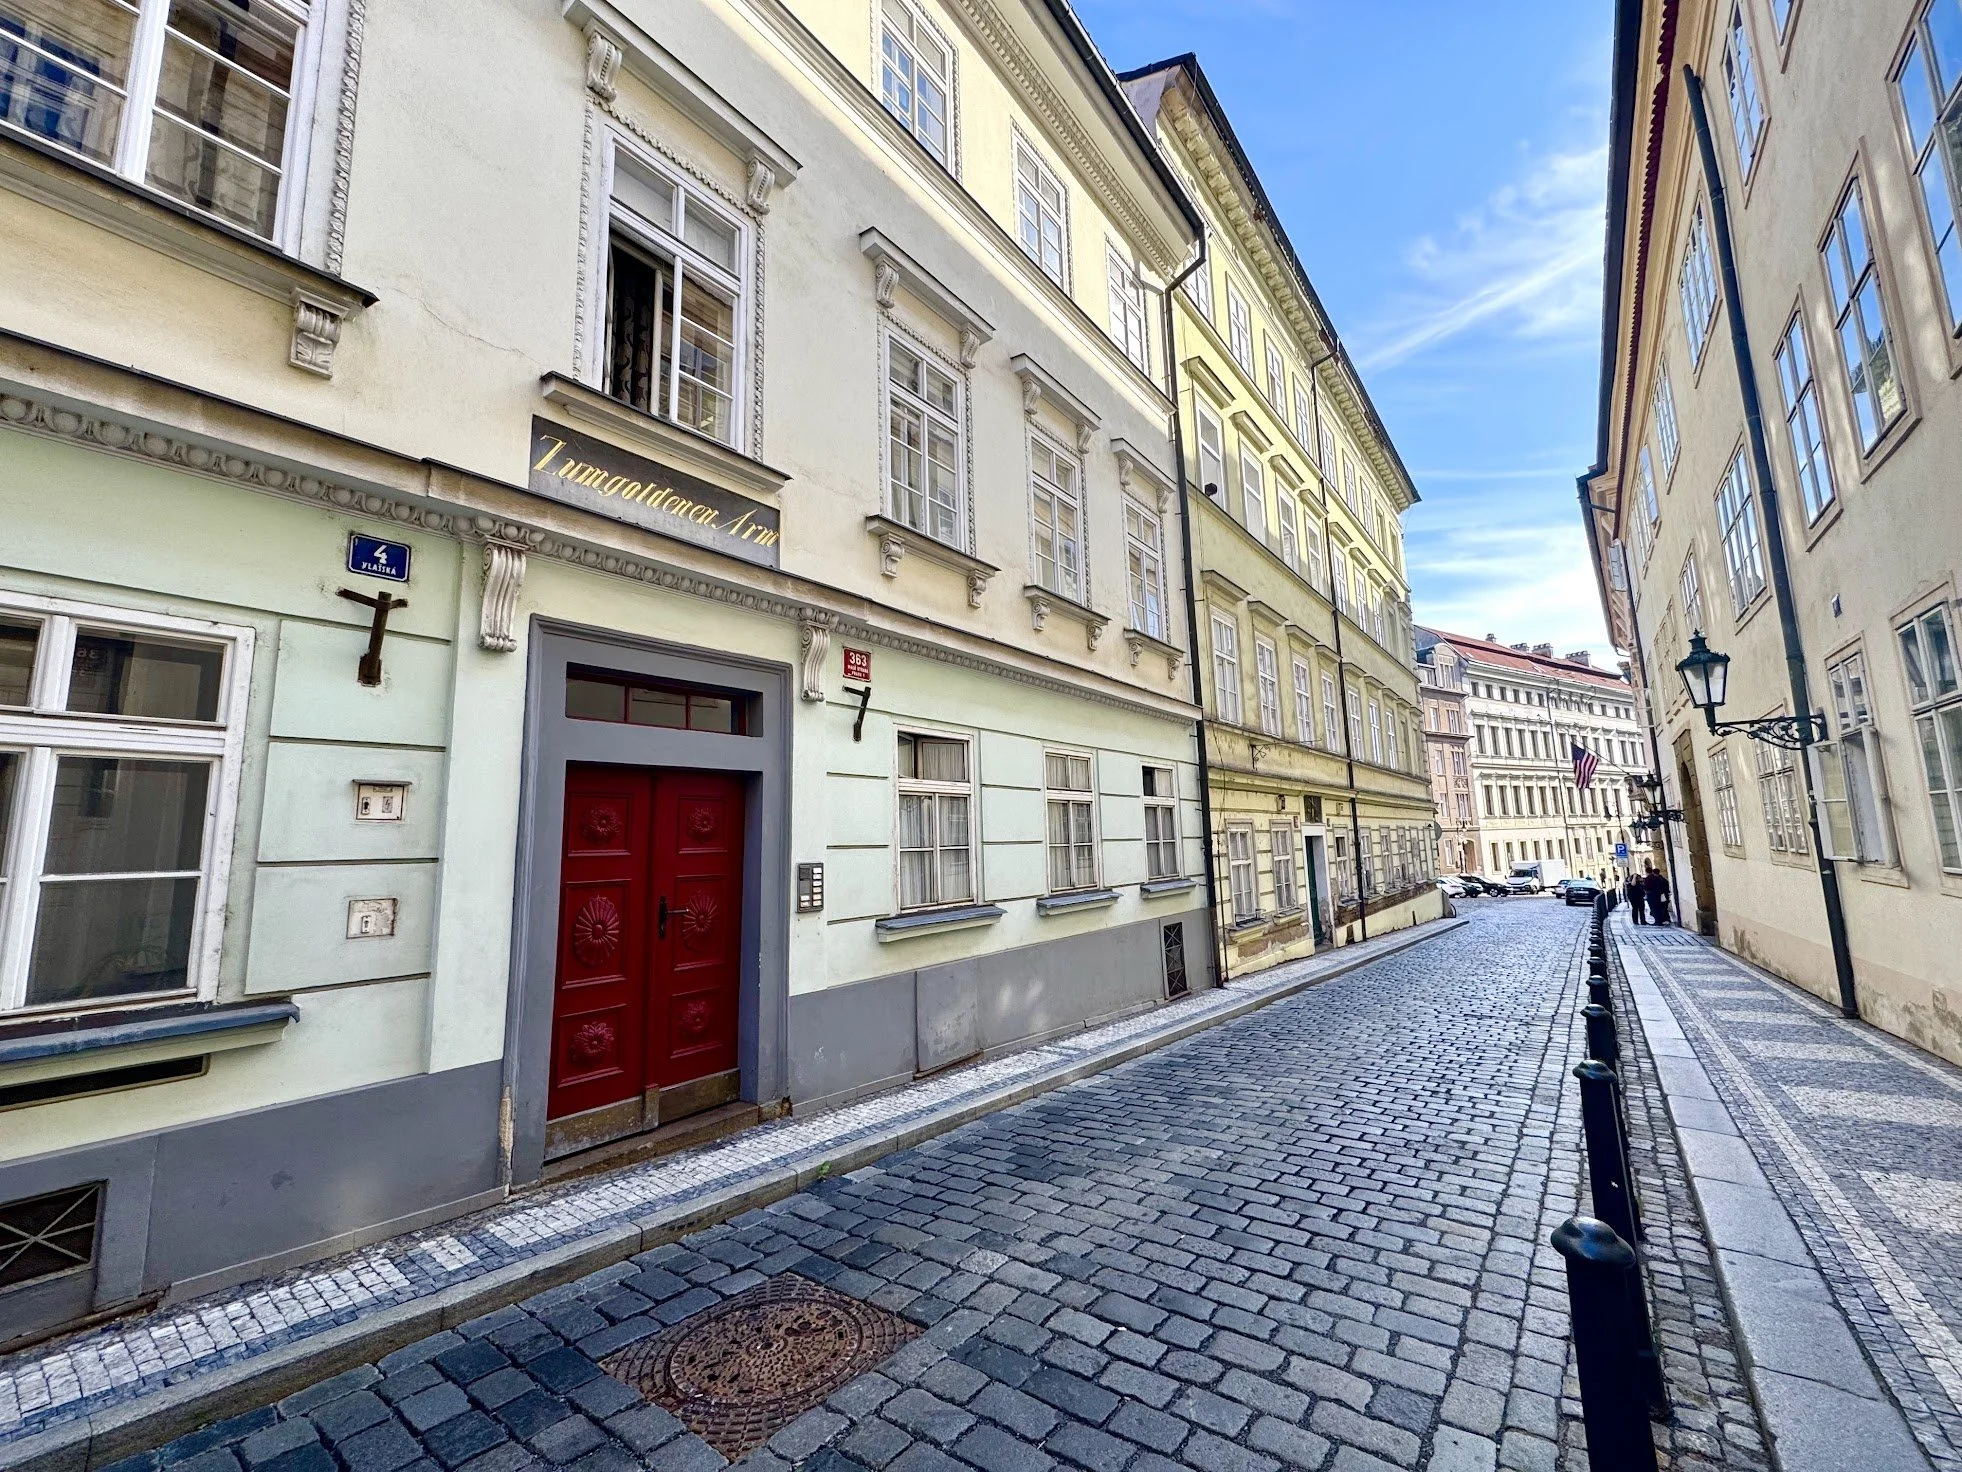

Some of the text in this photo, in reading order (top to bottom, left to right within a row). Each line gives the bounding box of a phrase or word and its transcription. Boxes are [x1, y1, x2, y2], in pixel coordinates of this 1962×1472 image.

[711, 508, 779, 547] Arm
[373, 544, 388, 565] 4
[361, 561, 397, 576] VLAŠSKÁ
[849, 651, 867, 667] 363
